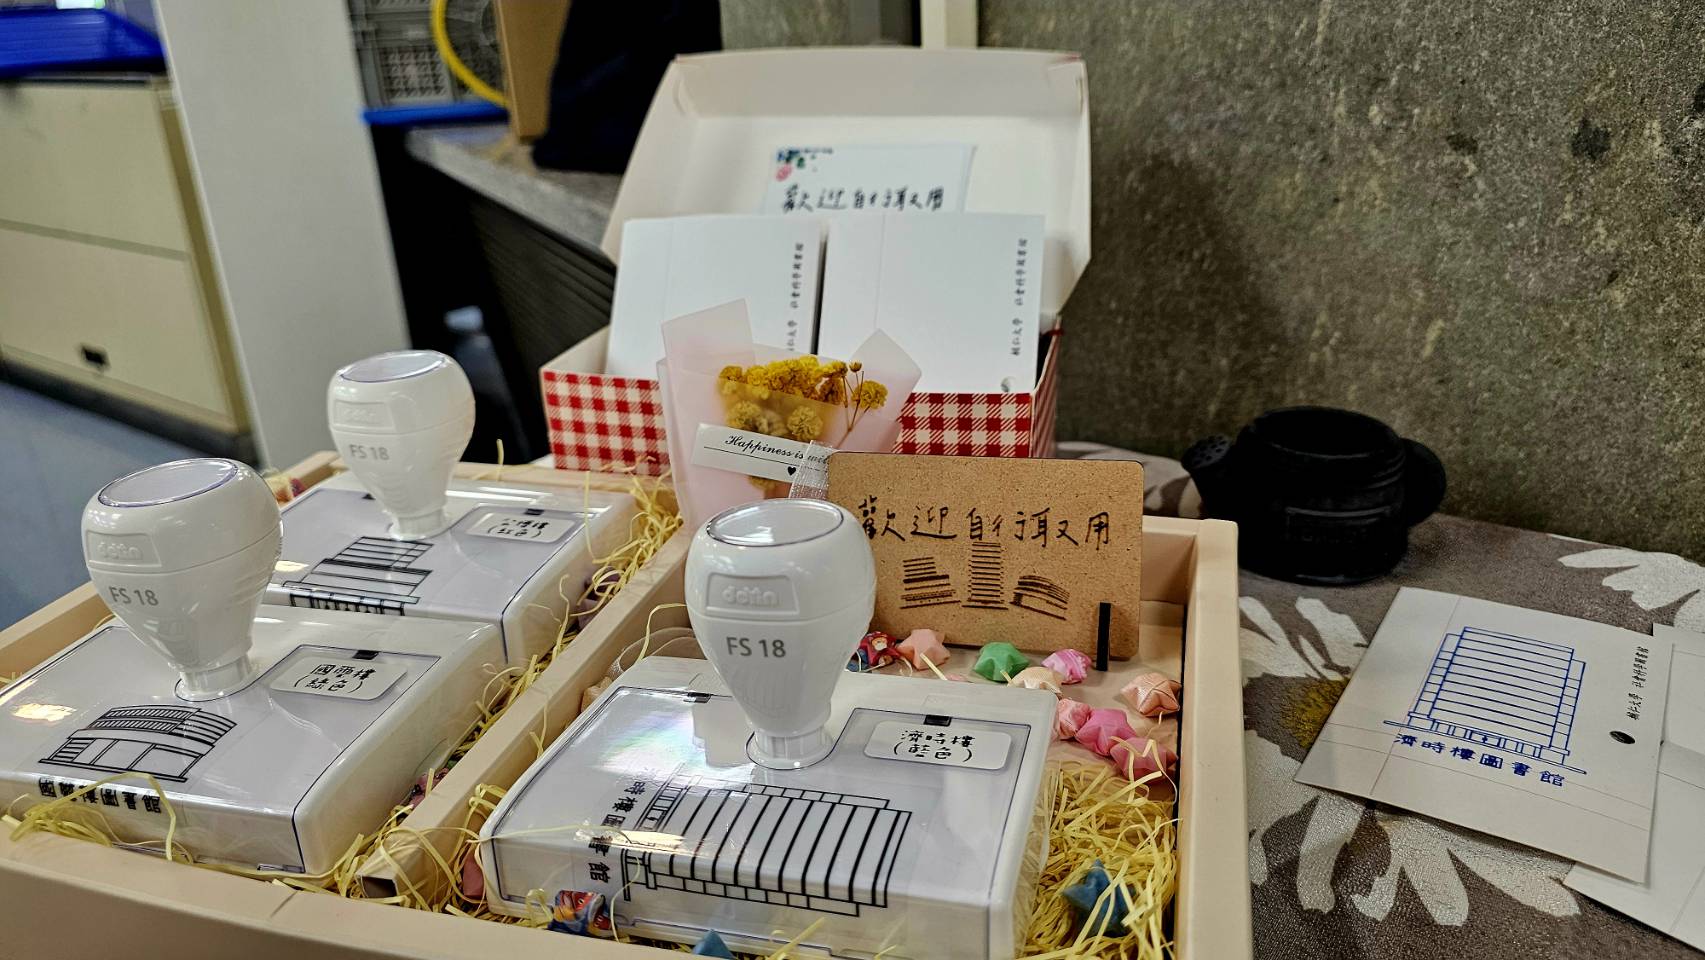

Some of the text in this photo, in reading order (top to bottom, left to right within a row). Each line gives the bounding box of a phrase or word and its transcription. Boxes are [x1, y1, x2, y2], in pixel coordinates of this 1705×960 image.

[349, 444, 390, 460] FS 18
[725, 435, 792, 456] Happiness
[794, 450, 804, 460] is
[857, 495, 1110, 551] 歡迎自行取用
[108, 586, 160, 606] FS 18
[726, 636, 787, 658] FS 18
[1393, 733, 1566, 787] 濟時樓圖書館
